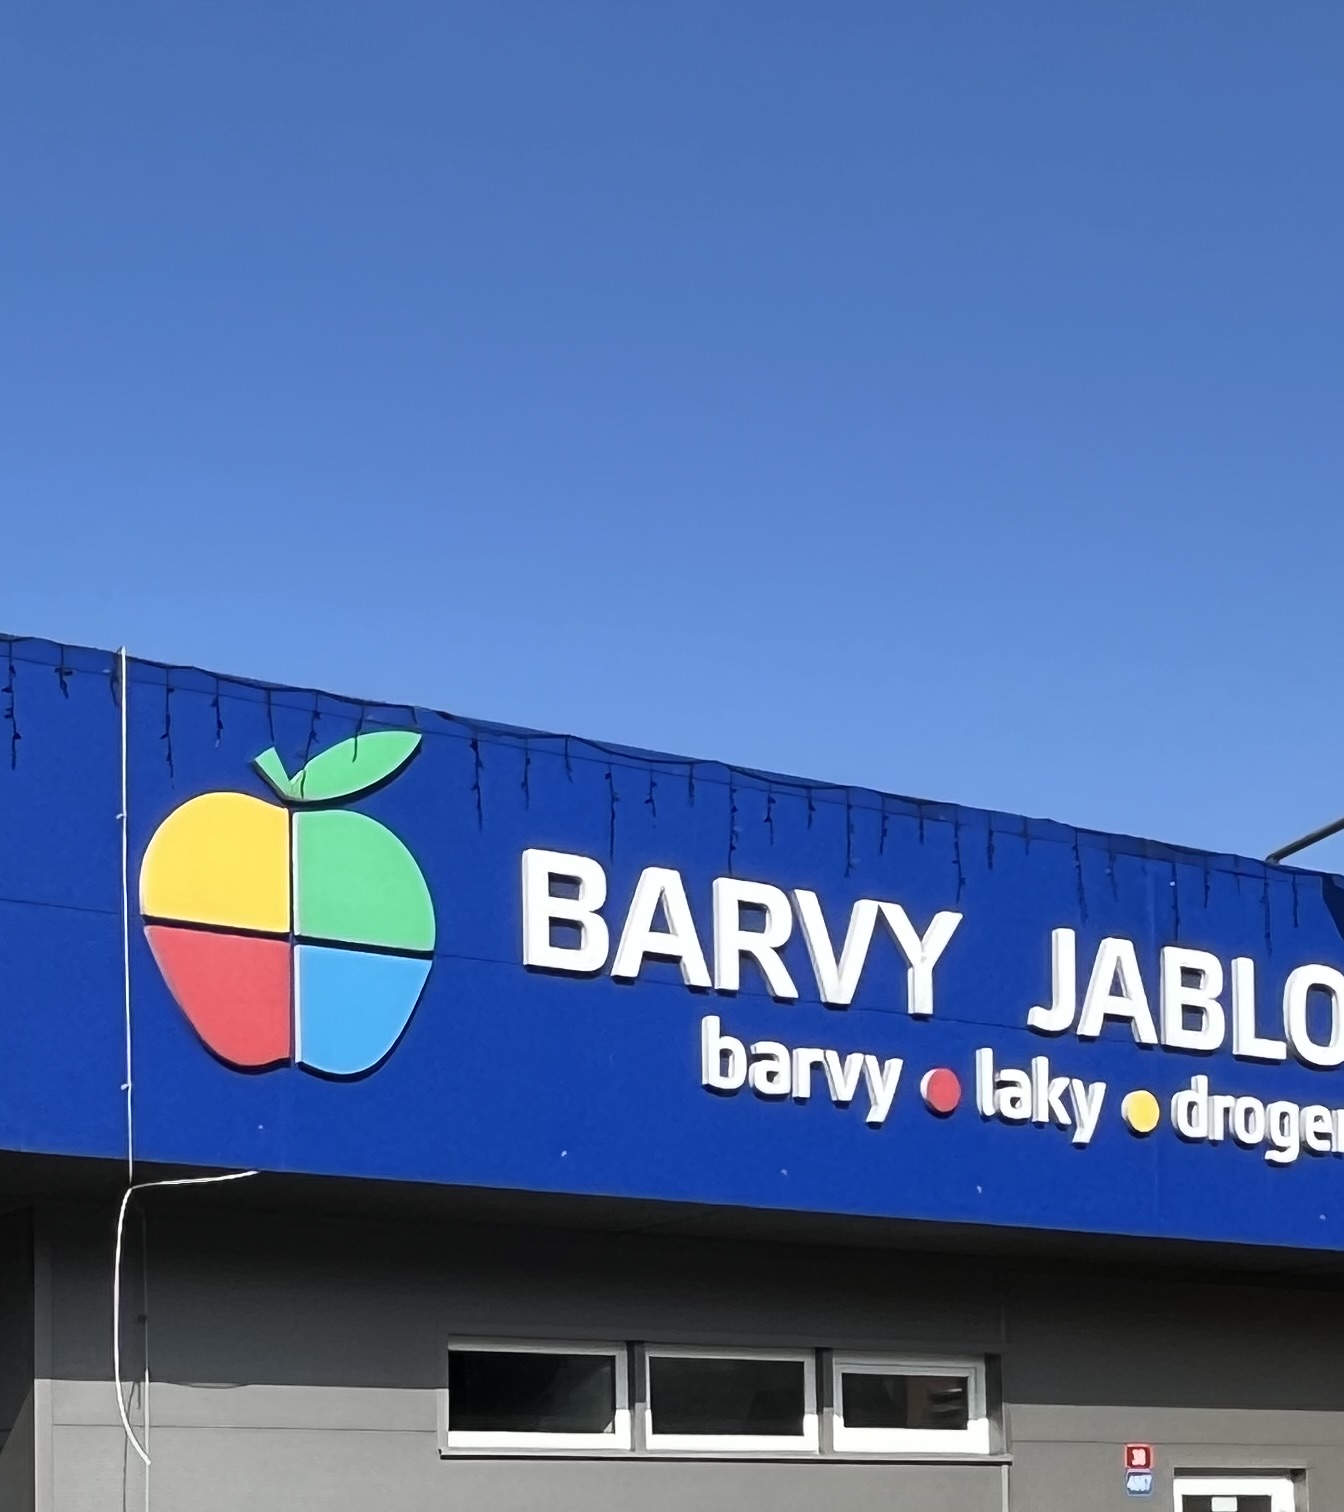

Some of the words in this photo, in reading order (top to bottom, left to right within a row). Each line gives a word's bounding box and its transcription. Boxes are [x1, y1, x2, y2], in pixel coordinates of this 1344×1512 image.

[520, 847, 964, 1017] BARVY
[700, 1014, 905, 1125] barvy
[974, 1046, 1108, 1145] laky
